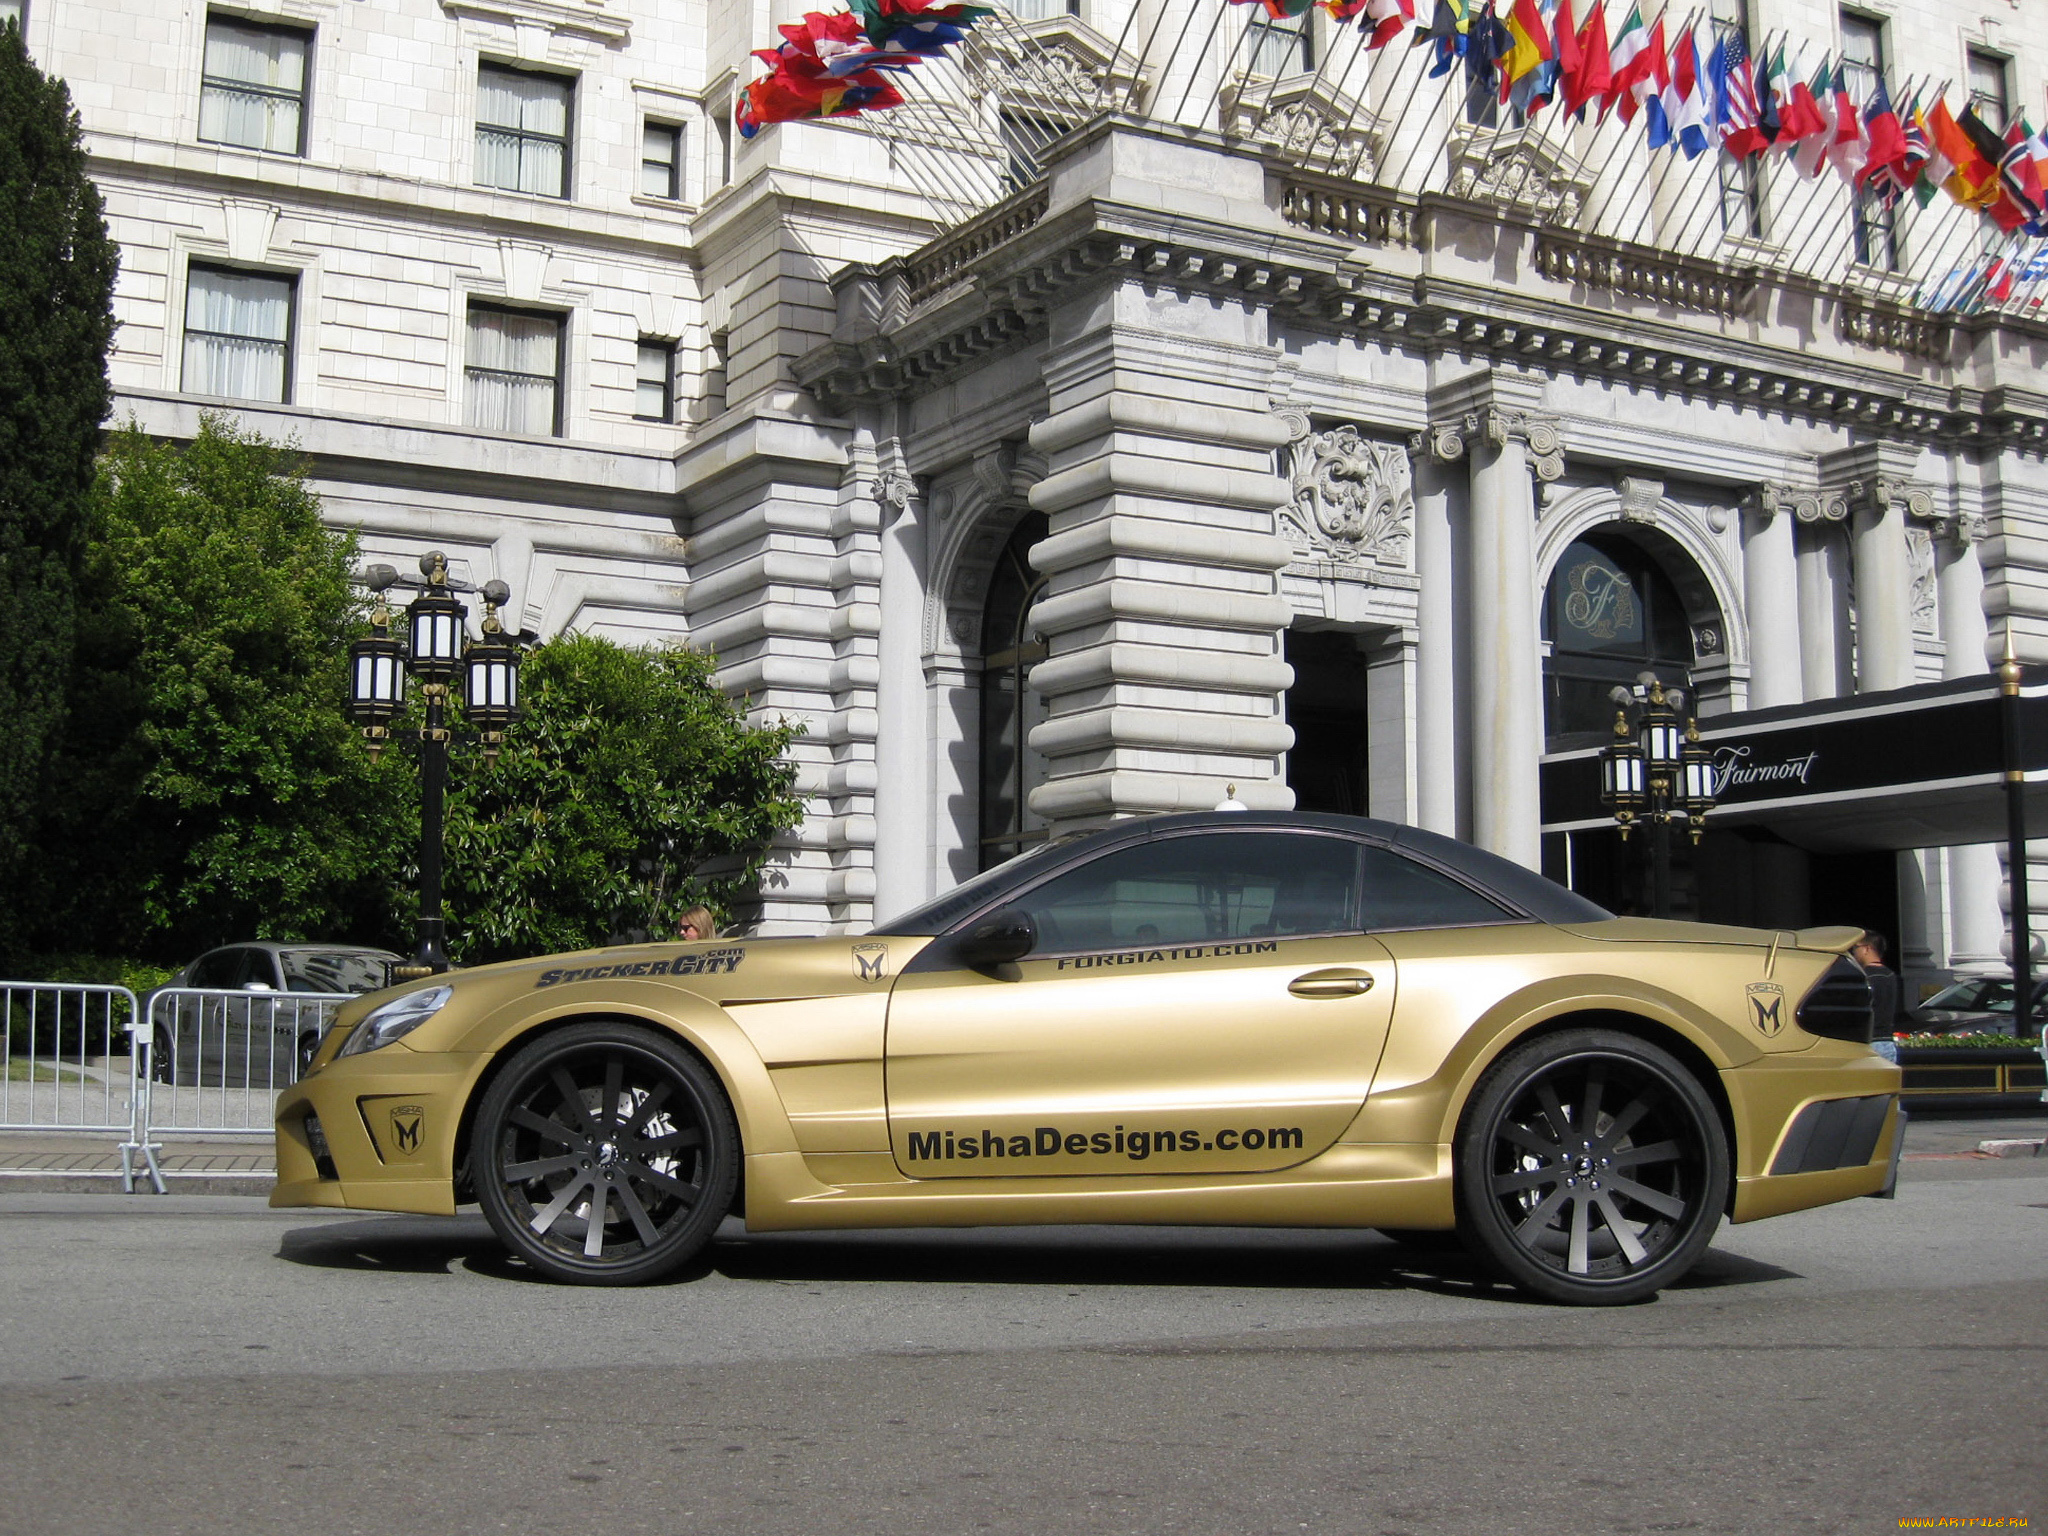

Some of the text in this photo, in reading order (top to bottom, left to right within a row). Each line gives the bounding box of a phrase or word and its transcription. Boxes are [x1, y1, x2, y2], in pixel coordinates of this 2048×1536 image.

[1713, 746, 1819, 795] Fairmont
[854, 951, 886, 981] M
[1057, 942, 1277, 970] FORGIATO.COM
[1750, 995, 1781, 1033] M
[393, 1117, 421, 1150] M
[907, 1125, 1303, 1160] MishaDesigns.com
